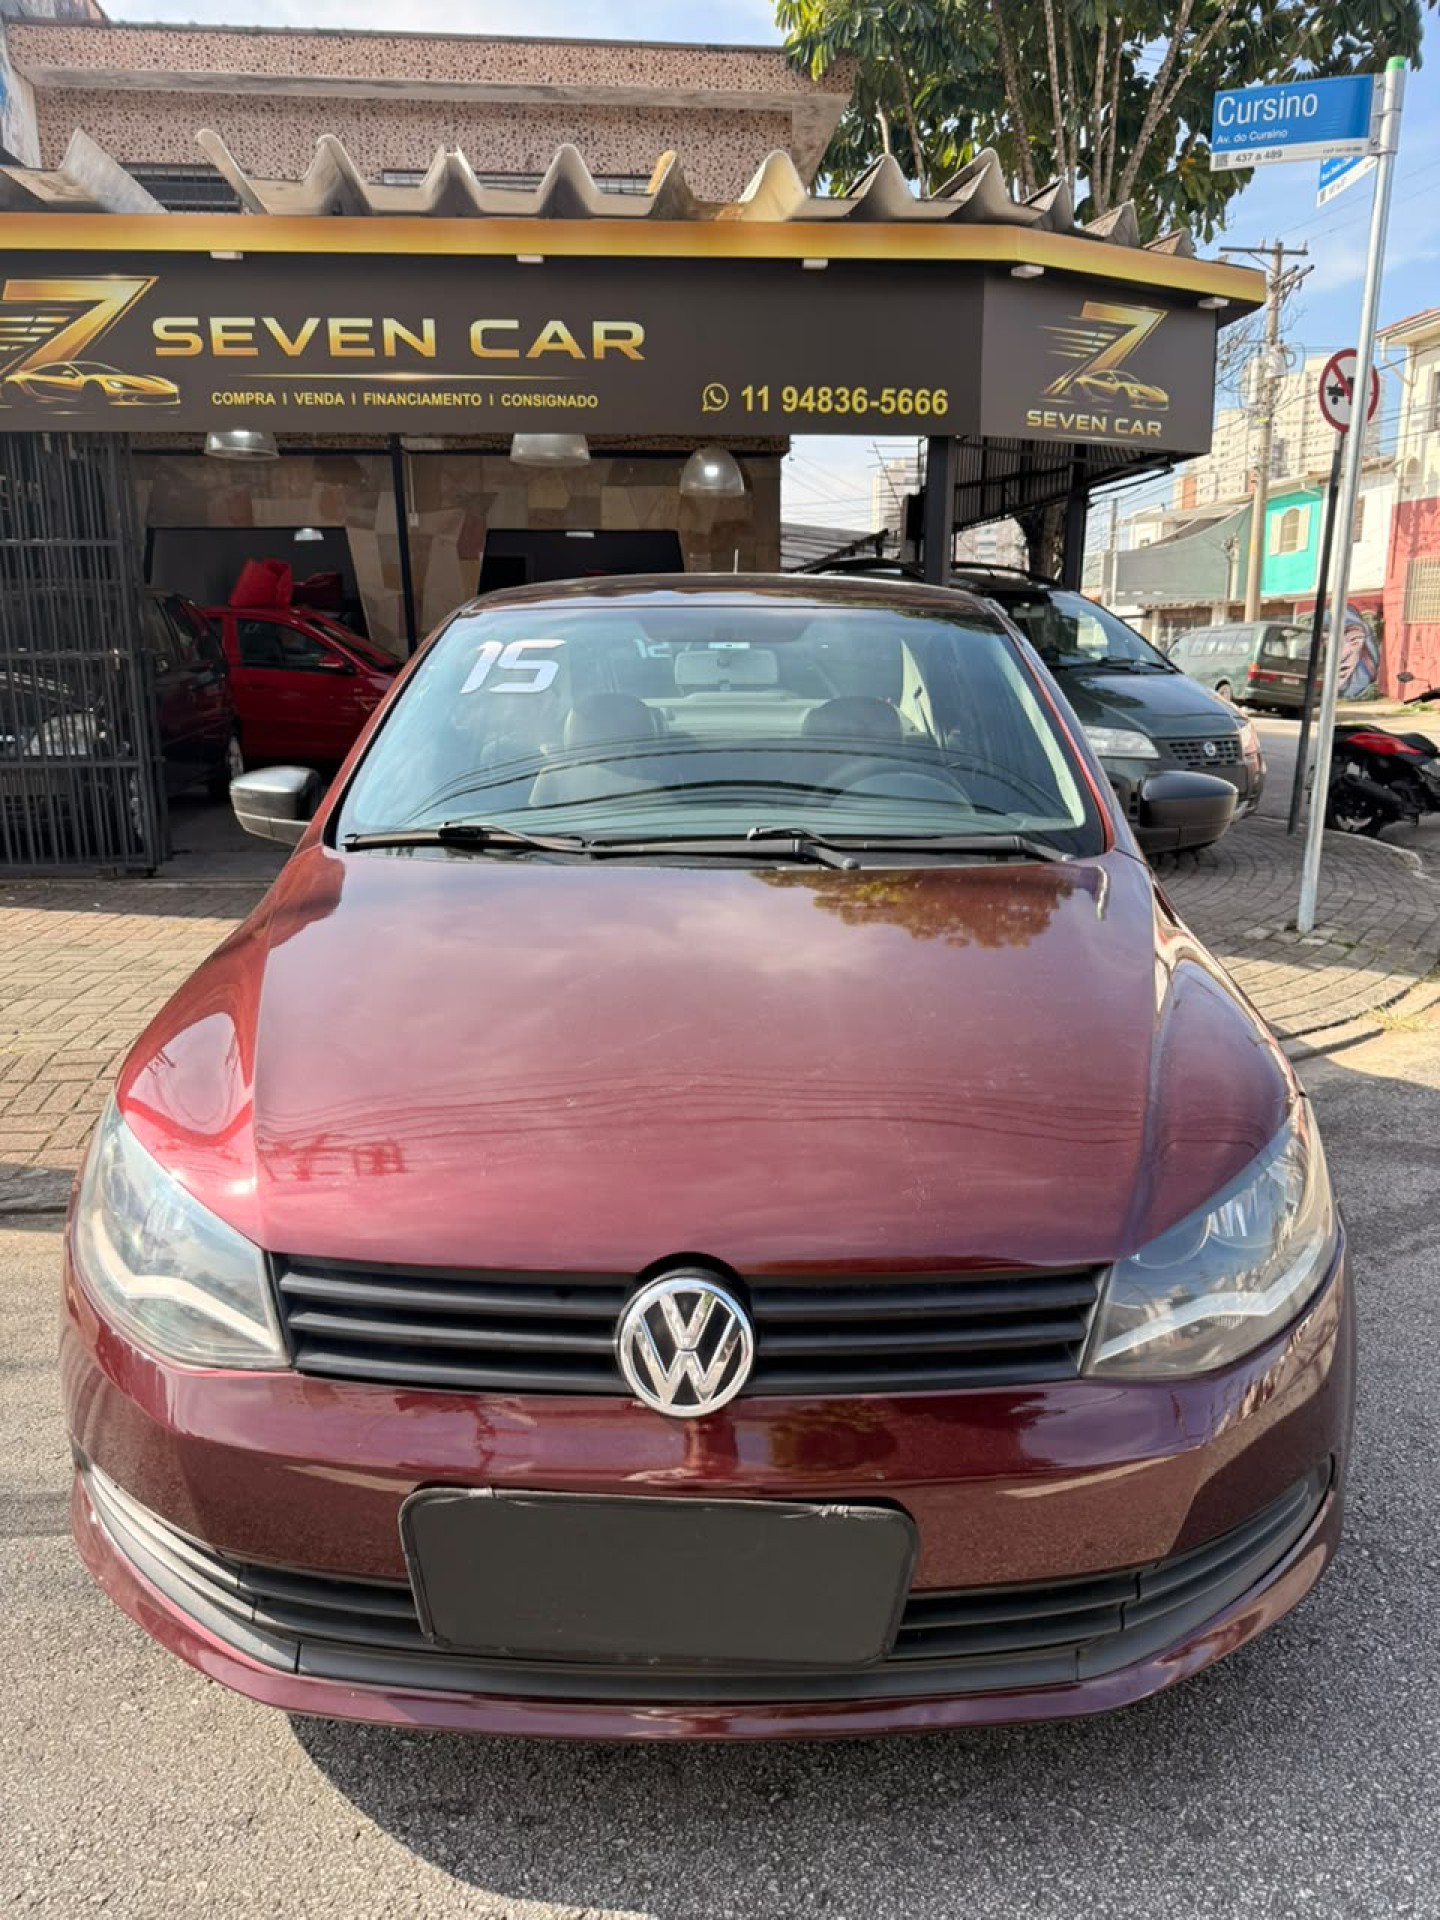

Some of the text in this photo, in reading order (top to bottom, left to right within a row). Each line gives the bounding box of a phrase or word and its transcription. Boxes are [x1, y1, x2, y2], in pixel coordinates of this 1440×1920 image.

[1217, 91, 1318, 127] Cursino
[1216, 129, 1288, 145] Av. do Cursino
[152, 316, 646, 360] SEVEN CAR
[211, 391, 276, 406] COMPRA
[293, 391, 346, 406] VENDA
[362, 391, 482, 407] FINANCIAMENTO
[500, 392, 599, 408] CONSIGNADO
[740, 384, 949, 415] 11 94836-5666
[1026, 409, 1162, 437] SEVEN CAR
[459, 638, 567, 694] 15
